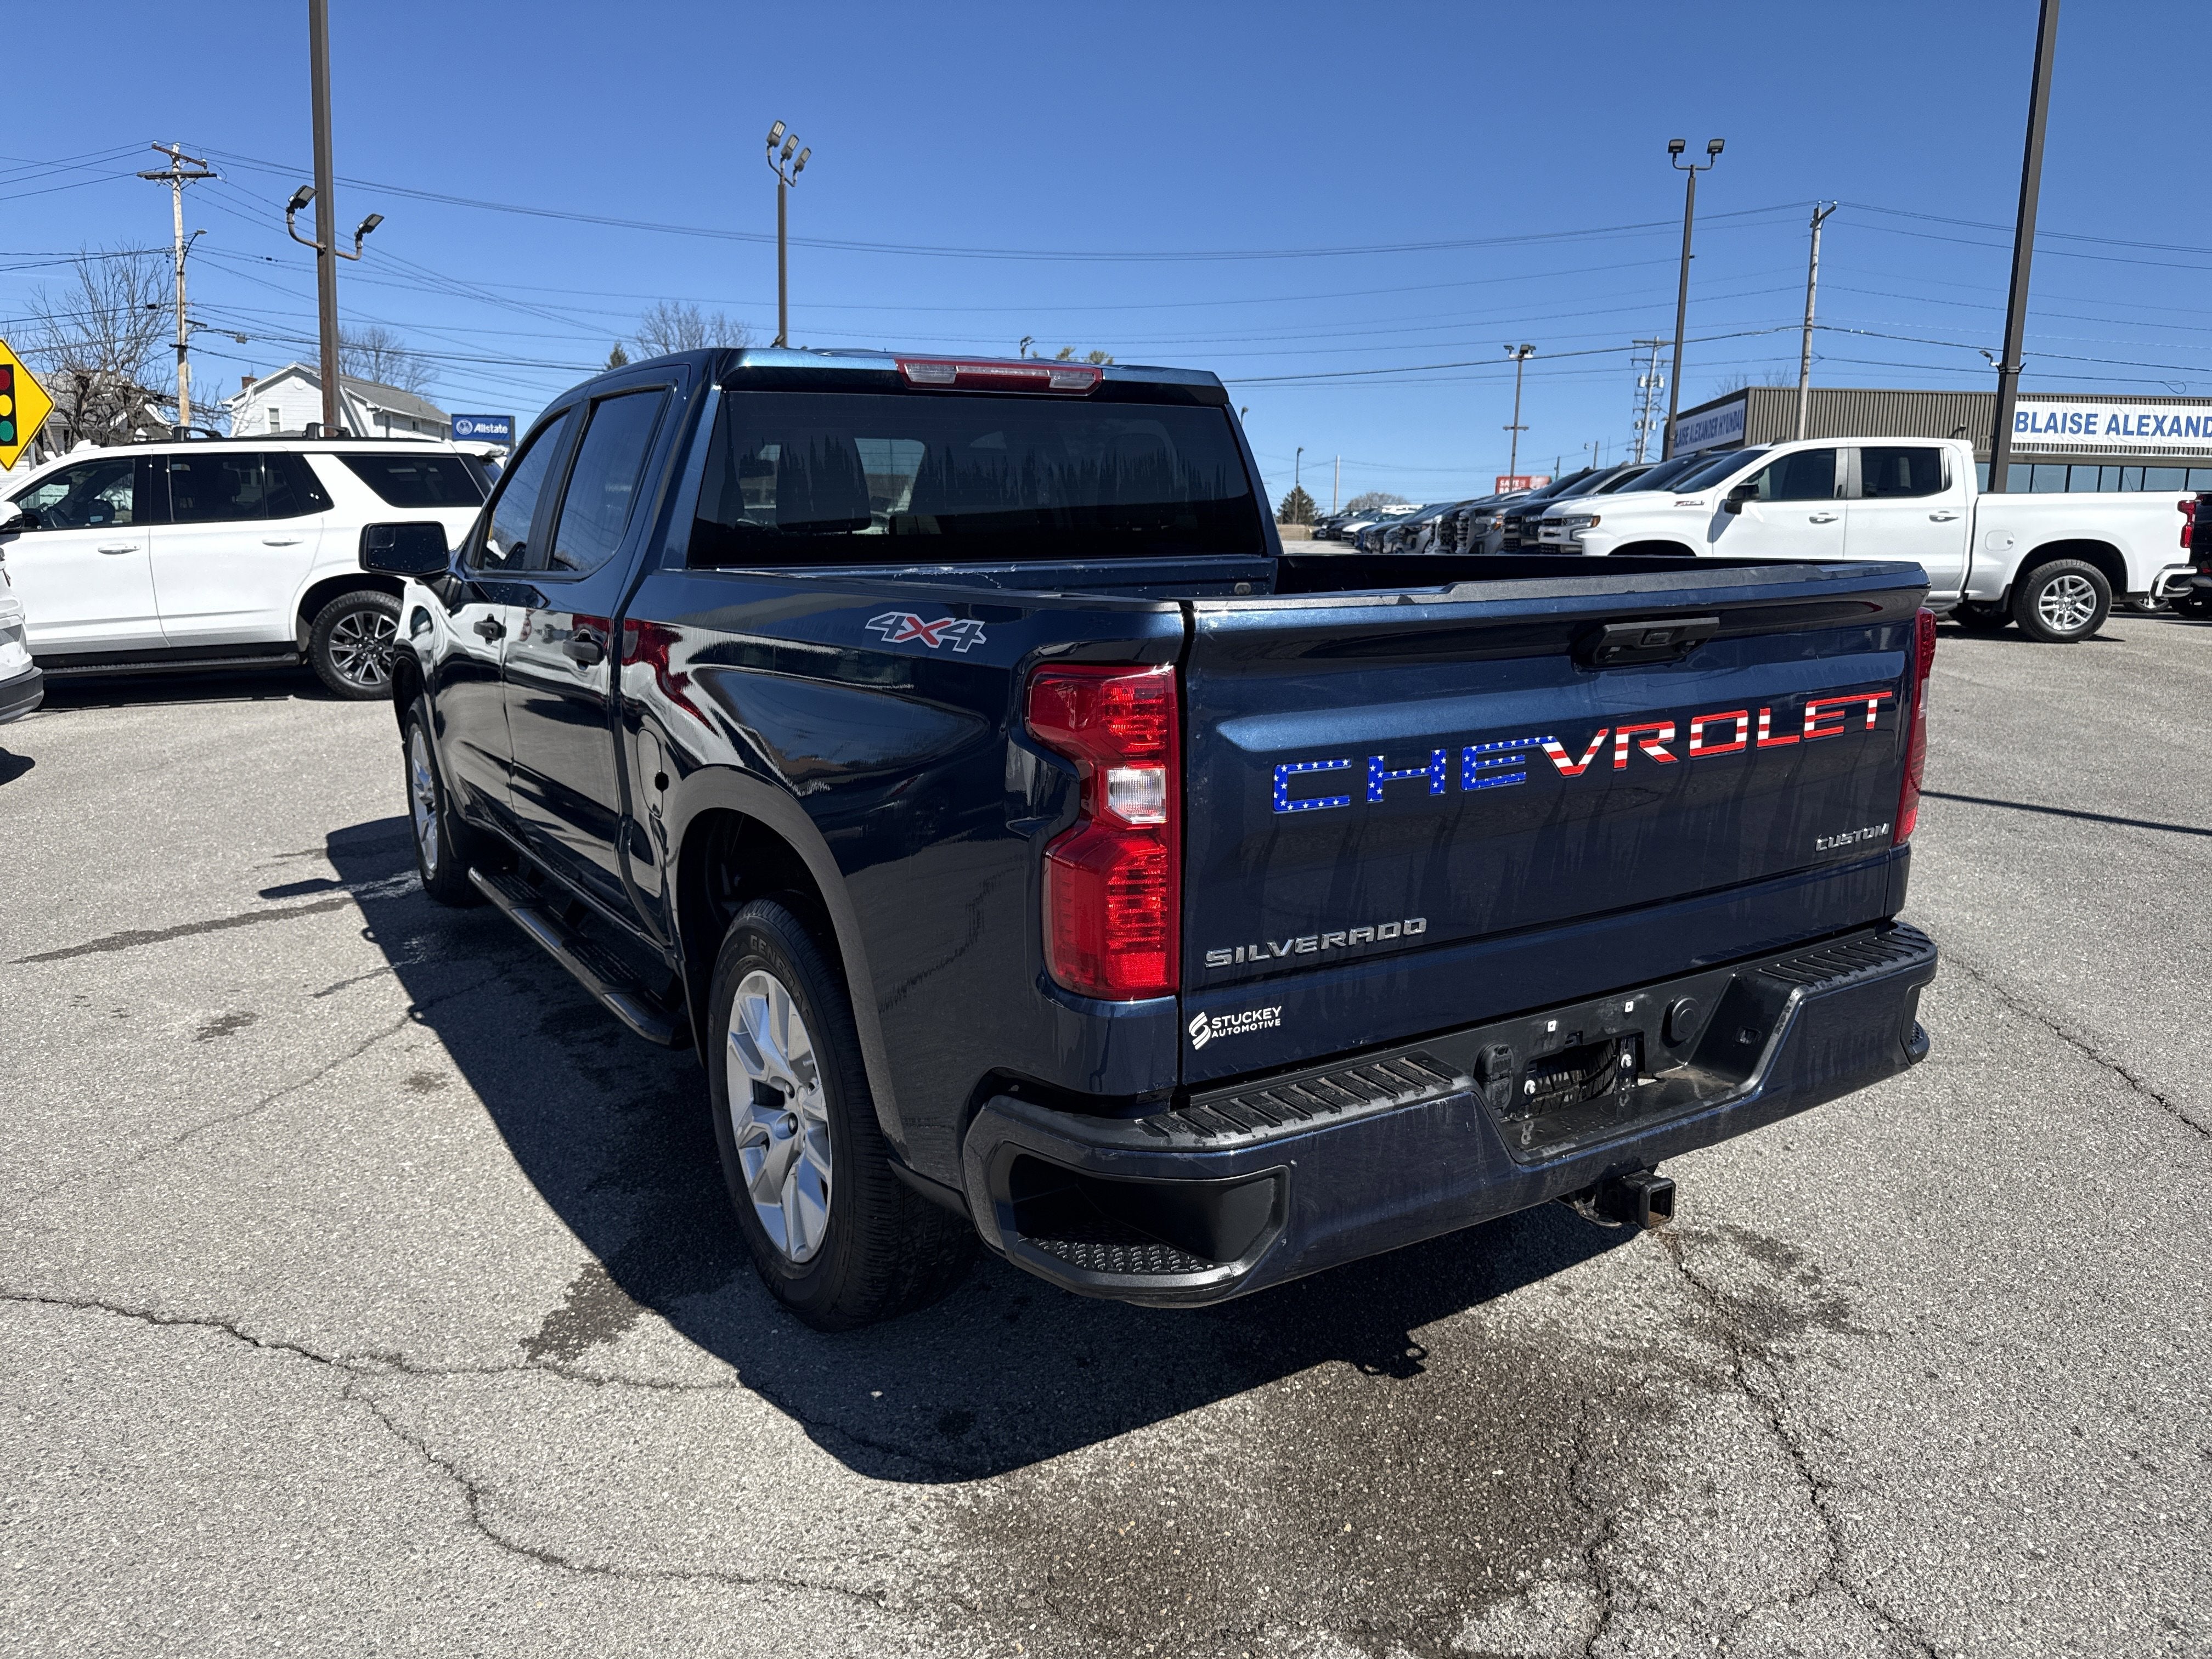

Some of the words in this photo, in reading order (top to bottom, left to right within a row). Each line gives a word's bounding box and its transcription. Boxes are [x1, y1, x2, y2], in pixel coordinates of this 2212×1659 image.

[473, 422, 508, 434] Allstate
[1674, 426, 1689, 448] LAISE
[2015, 412, 2098, 434] BLAISE
[2105, 414, 2212, 438] ALEXAND
[1273, 690, 1893, 813] CHEVROLET
[1815, 822, 1889, 851] CUSTOM
[1205, 917, 1427, 968] SILVERADO
[1211, 1006, 1282, 1030] STUCKEY
[1211, 1018, 1281, 1039] AUTOMOTIVE
